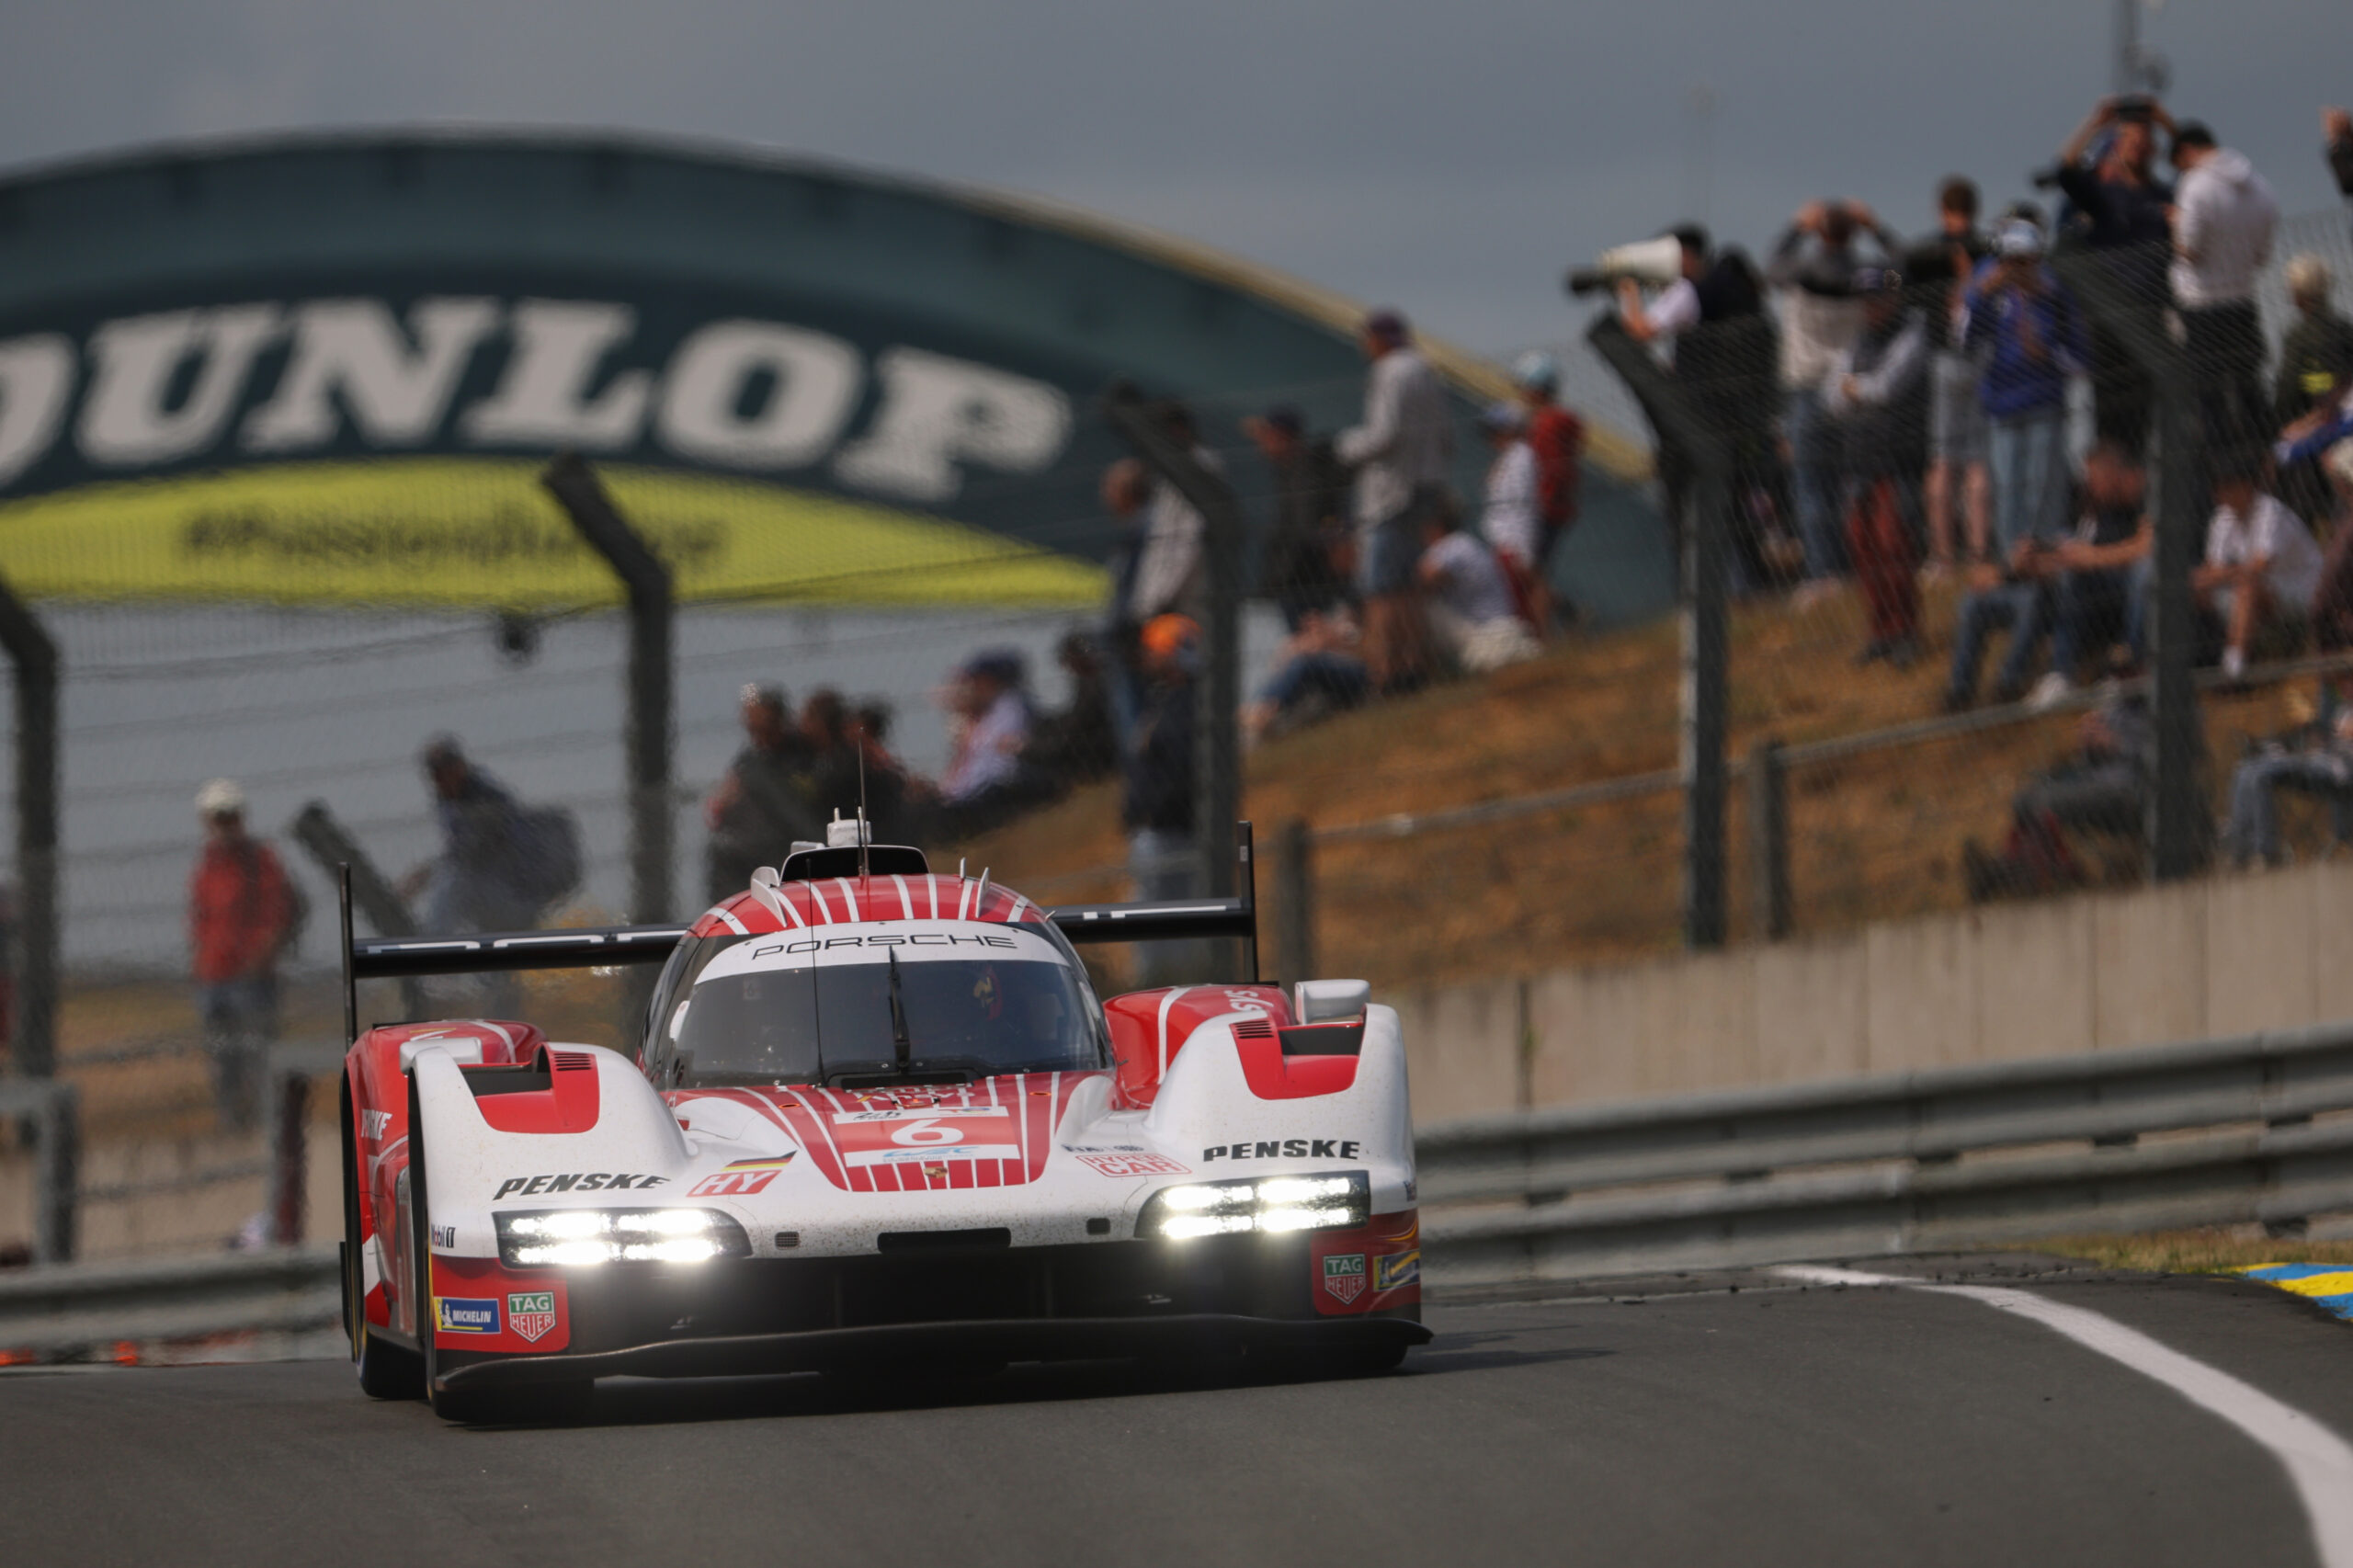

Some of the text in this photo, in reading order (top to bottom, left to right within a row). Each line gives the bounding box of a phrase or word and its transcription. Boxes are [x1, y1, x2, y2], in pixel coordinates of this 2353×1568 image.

[752, 934, 1017, 960] PORSCHE
[890, 1118, 964, 1146] 6
[1085, 1154, 1165, 1164] HYPER
[1203, 1139, 1360, 1162] PENSKE
[1098, 1161, 1184, 1175] CAR
[492, 1172, 671, 1200] PENSKE
[691, 1170, 775, 1194] HY
[1327, 1258, 1362, 1274] TAG
[1327, 1276, 1365, 1300] HEUER
[511, 1296, 550, 1312] TAG
[452, 1309, 492, 1324] MICHELIN
[511, 1314, 552, 1338] HEUER
